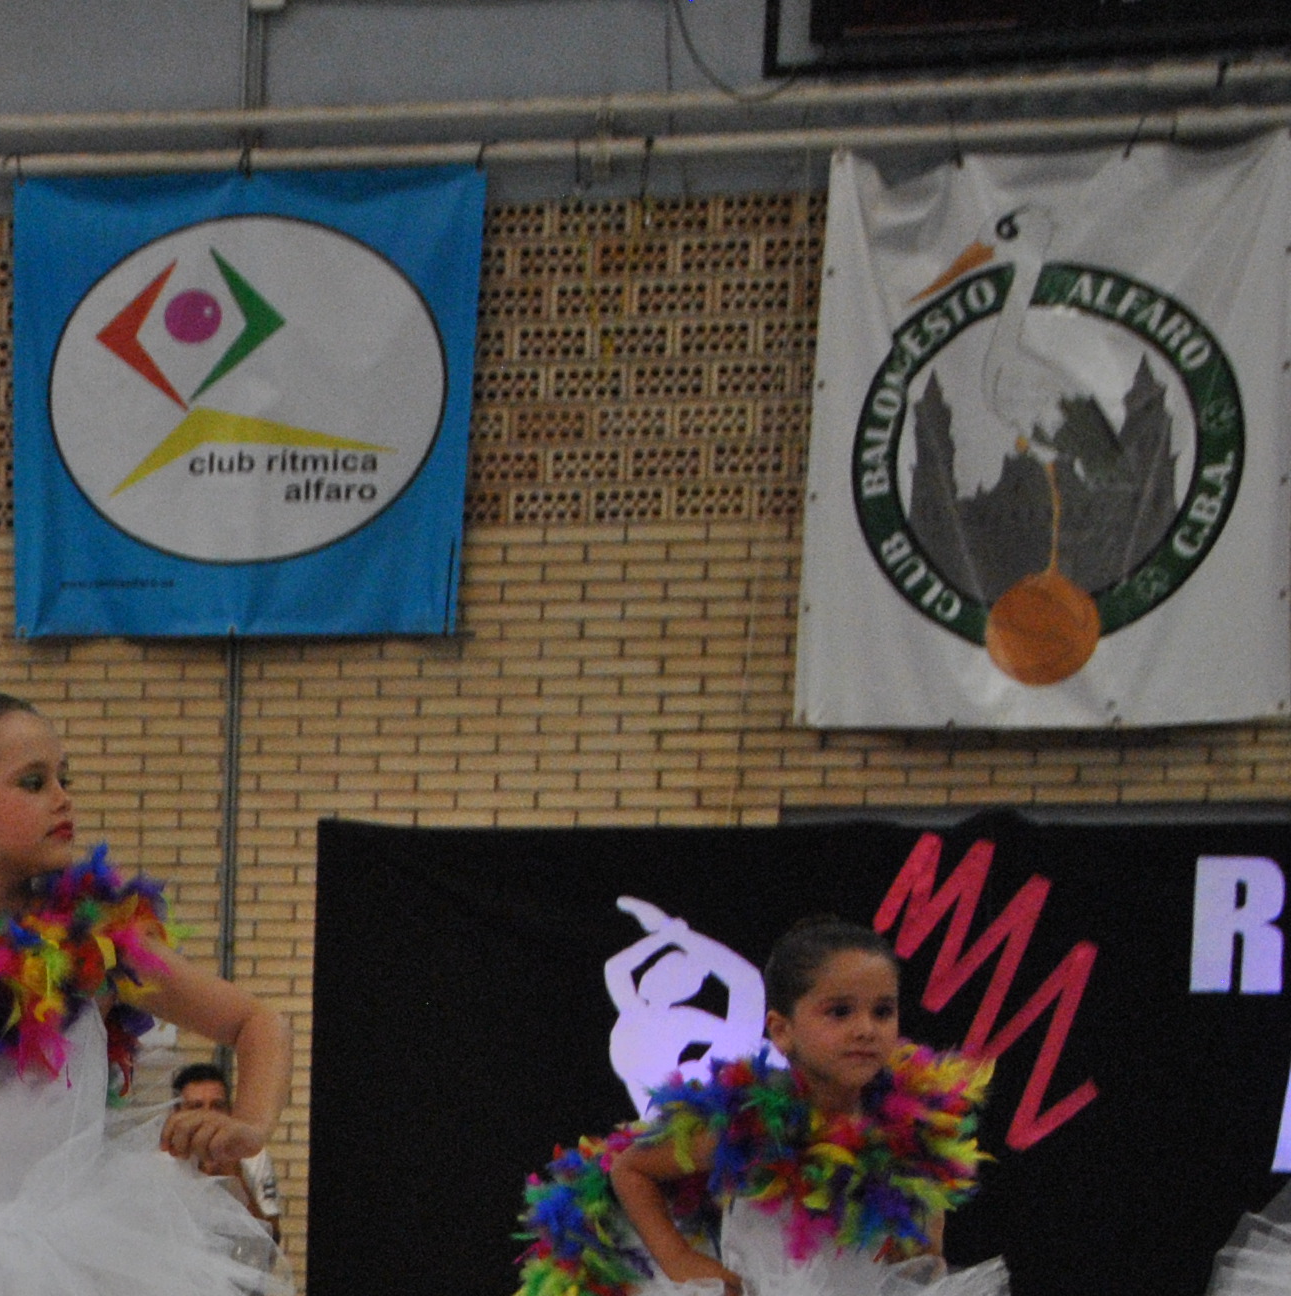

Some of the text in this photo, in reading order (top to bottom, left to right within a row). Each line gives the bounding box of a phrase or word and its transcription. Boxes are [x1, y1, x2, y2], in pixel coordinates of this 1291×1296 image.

[1068, 272, 1210, 370] ALFARO
[862, 279, 997, 497] BALOESTO
[189, 451, 255, 474] club
[285, 478, 378, 502] alfaro
[881, 532, 961, 621] CLUB
